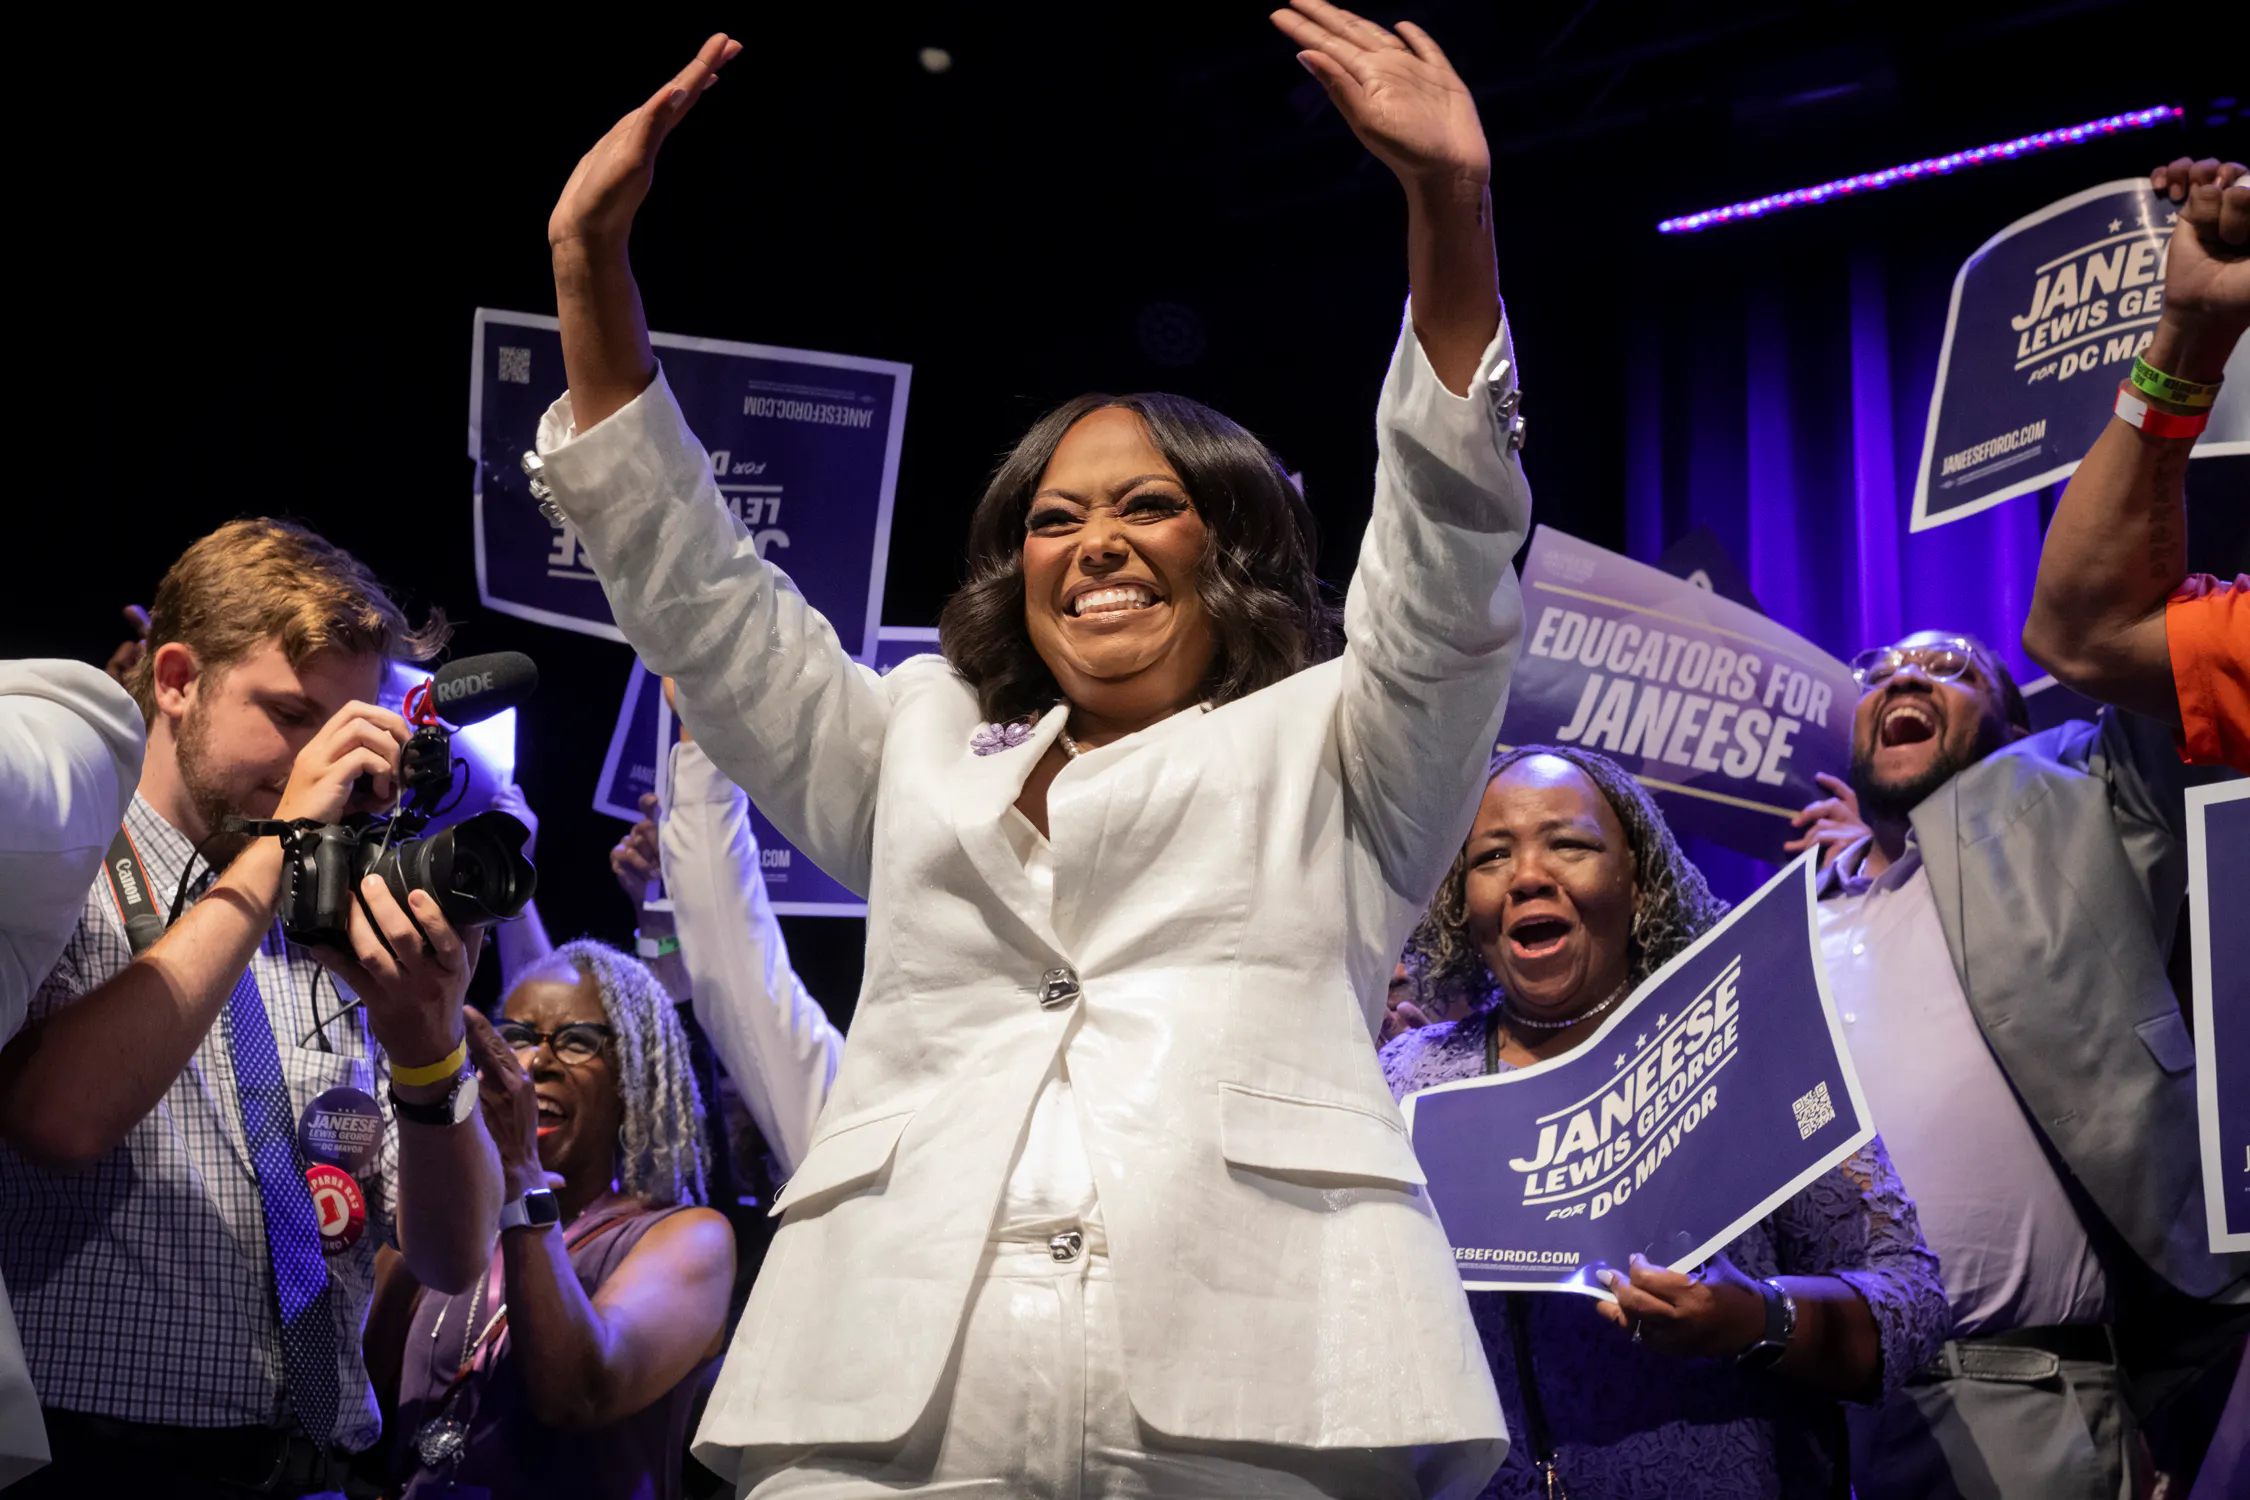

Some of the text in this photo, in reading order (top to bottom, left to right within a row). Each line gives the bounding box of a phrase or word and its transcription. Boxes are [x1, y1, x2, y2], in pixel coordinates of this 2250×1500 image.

[2017, 285, 2166, 359] LEWIS GE
[2028, 362, 2058, 385] FOR
[2058, 345, 2100, 382] DC
[2103, 331, 2154, 365] MA
[743, 396, 874, 428] JANEESEFORDC.COM
[1941, 419, 2047, 476] JANEESEFORDC.COM
[437, 671, 495, 703] RØDE
[1529, 606, 1834, 728] EDUCATORS FOR
[1556, 674, 1801, 786] JANEESE
[115, 857, 143, 905] Canon
[1508, 966, 1742, 1172] JANEESE
[308, 1114, 379, 1134] JANEESE
[1523, 1014, 1740, 1197] LEWIS GEORGE
[308, 1128, 375, 1143] LEWIS GEORGE
[321, 1142, 334, 1151] DC
[334, 1144, 364, 1154] MAYOR
[1545, 1085, 1718, 1222] FOR DC MAYOR
[309, 1175, 344, 1192] PARNA
